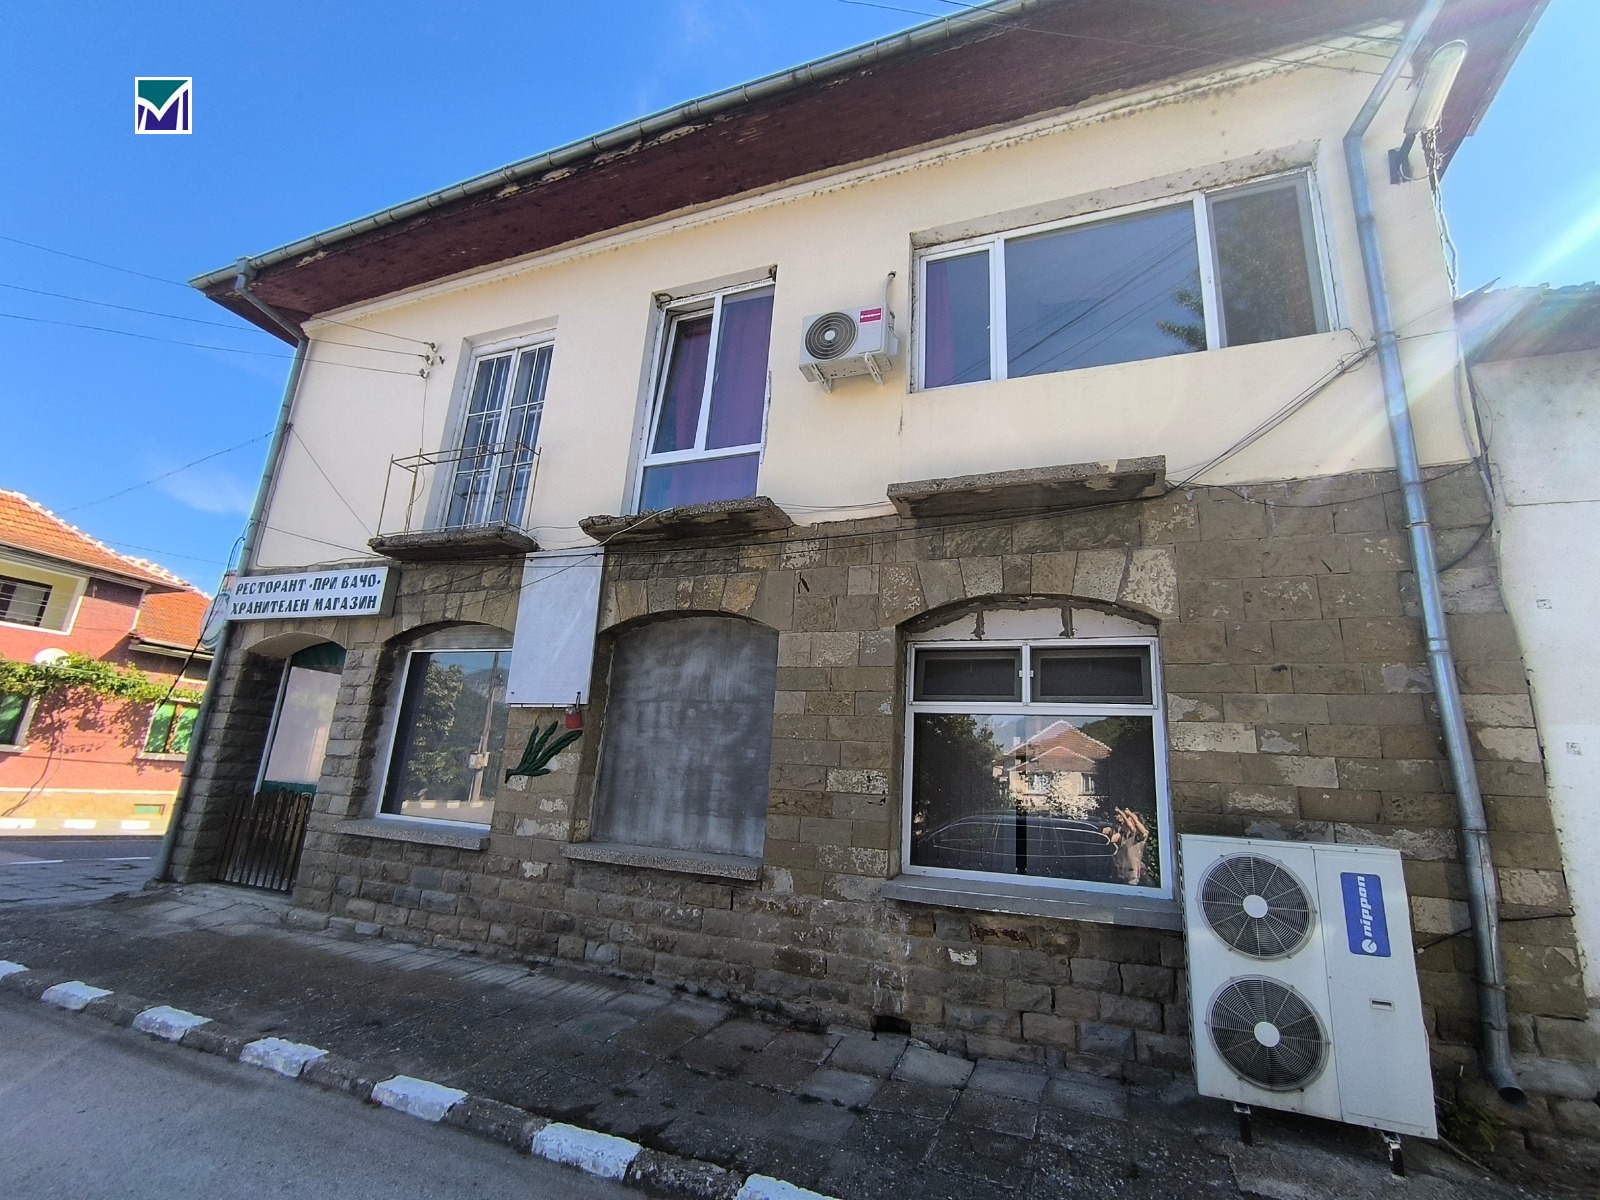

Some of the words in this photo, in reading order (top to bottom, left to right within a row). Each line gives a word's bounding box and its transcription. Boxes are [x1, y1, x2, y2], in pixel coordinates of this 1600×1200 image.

[235, 579, 306, 596] РЕСТОРАНТ
[230, 599, 309, 615] ХРАНИТЕЛЕН
[312, 595, 377, 611] МАГАЗИН
[1357, 875, 1374, 938] nippon
